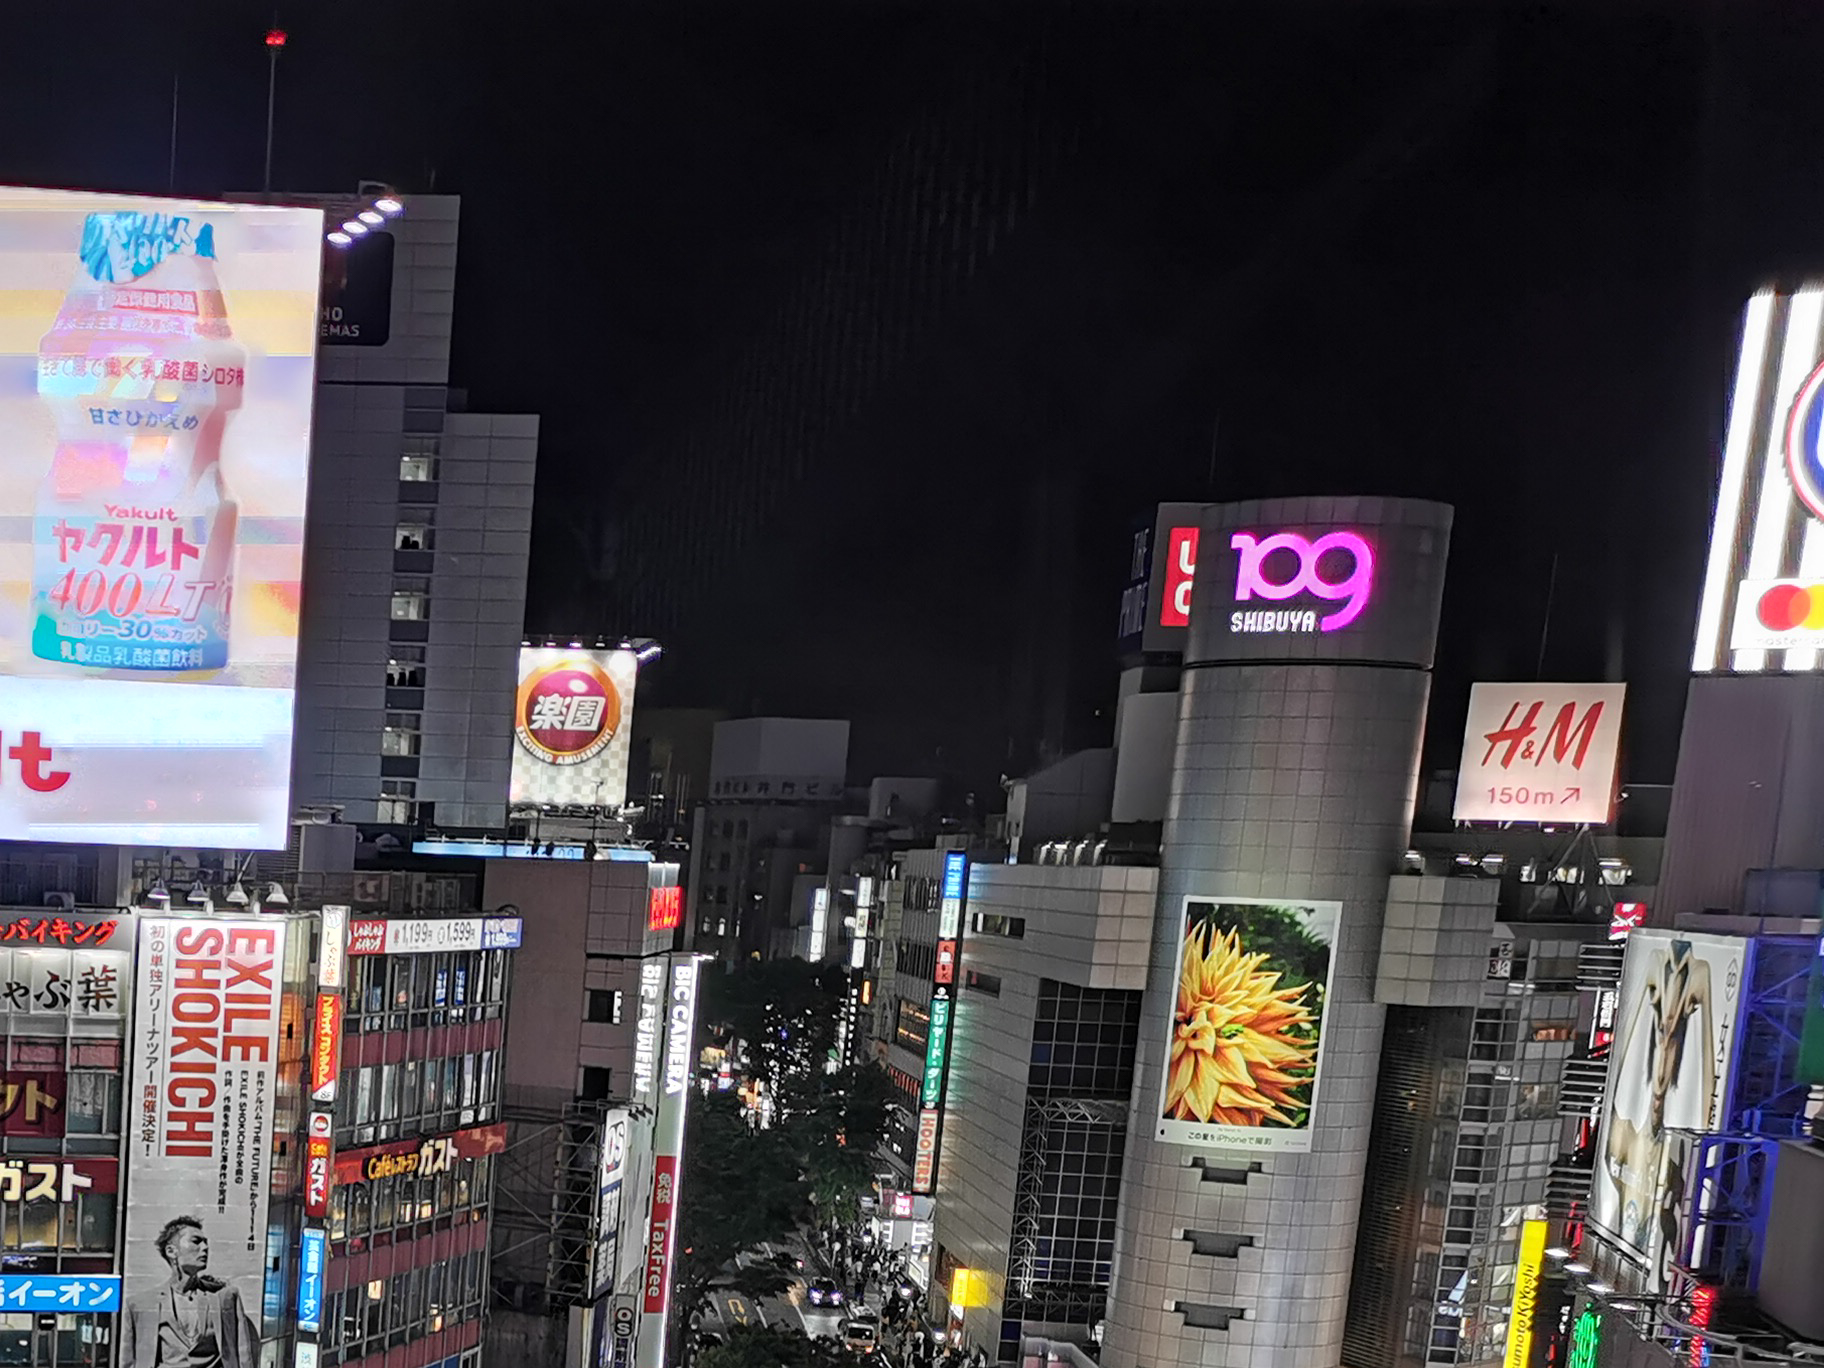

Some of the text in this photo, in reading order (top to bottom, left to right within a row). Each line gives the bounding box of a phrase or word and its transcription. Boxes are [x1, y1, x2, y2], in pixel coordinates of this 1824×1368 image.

[318, 324, 360, 337] EMAS
[89, 406, 199, 430] 甘さひかえめ
[104, 503, 178, 521] Yakult
[52, 518, 199, 570] ヤクルト
[1230, 531, 1375, 632] 109
[1230, 612, 1317, 633] SHIBUYA
[60, 640, 203, 667] 乳製品乳酸菌飲料
[529, 693, 606, 731] 楽園
[1482, 701, 1605, 770] H&M
[516, 726, 614, 764] EXCITING AMUSEMENT
[221, 927, 275, 1063] EXILE
[165, 927, 224, 1158] SHOKICHI
[665, 965, 692, 1095] BIC CAMERA
[418, 1137, 458, 1177] ガスト
[916, 1116, 936, 1186] HOOTERS
[309, 1157, 326, 1206] ガスト
[302, 1240, 319, 1320] 英会話イーオン
